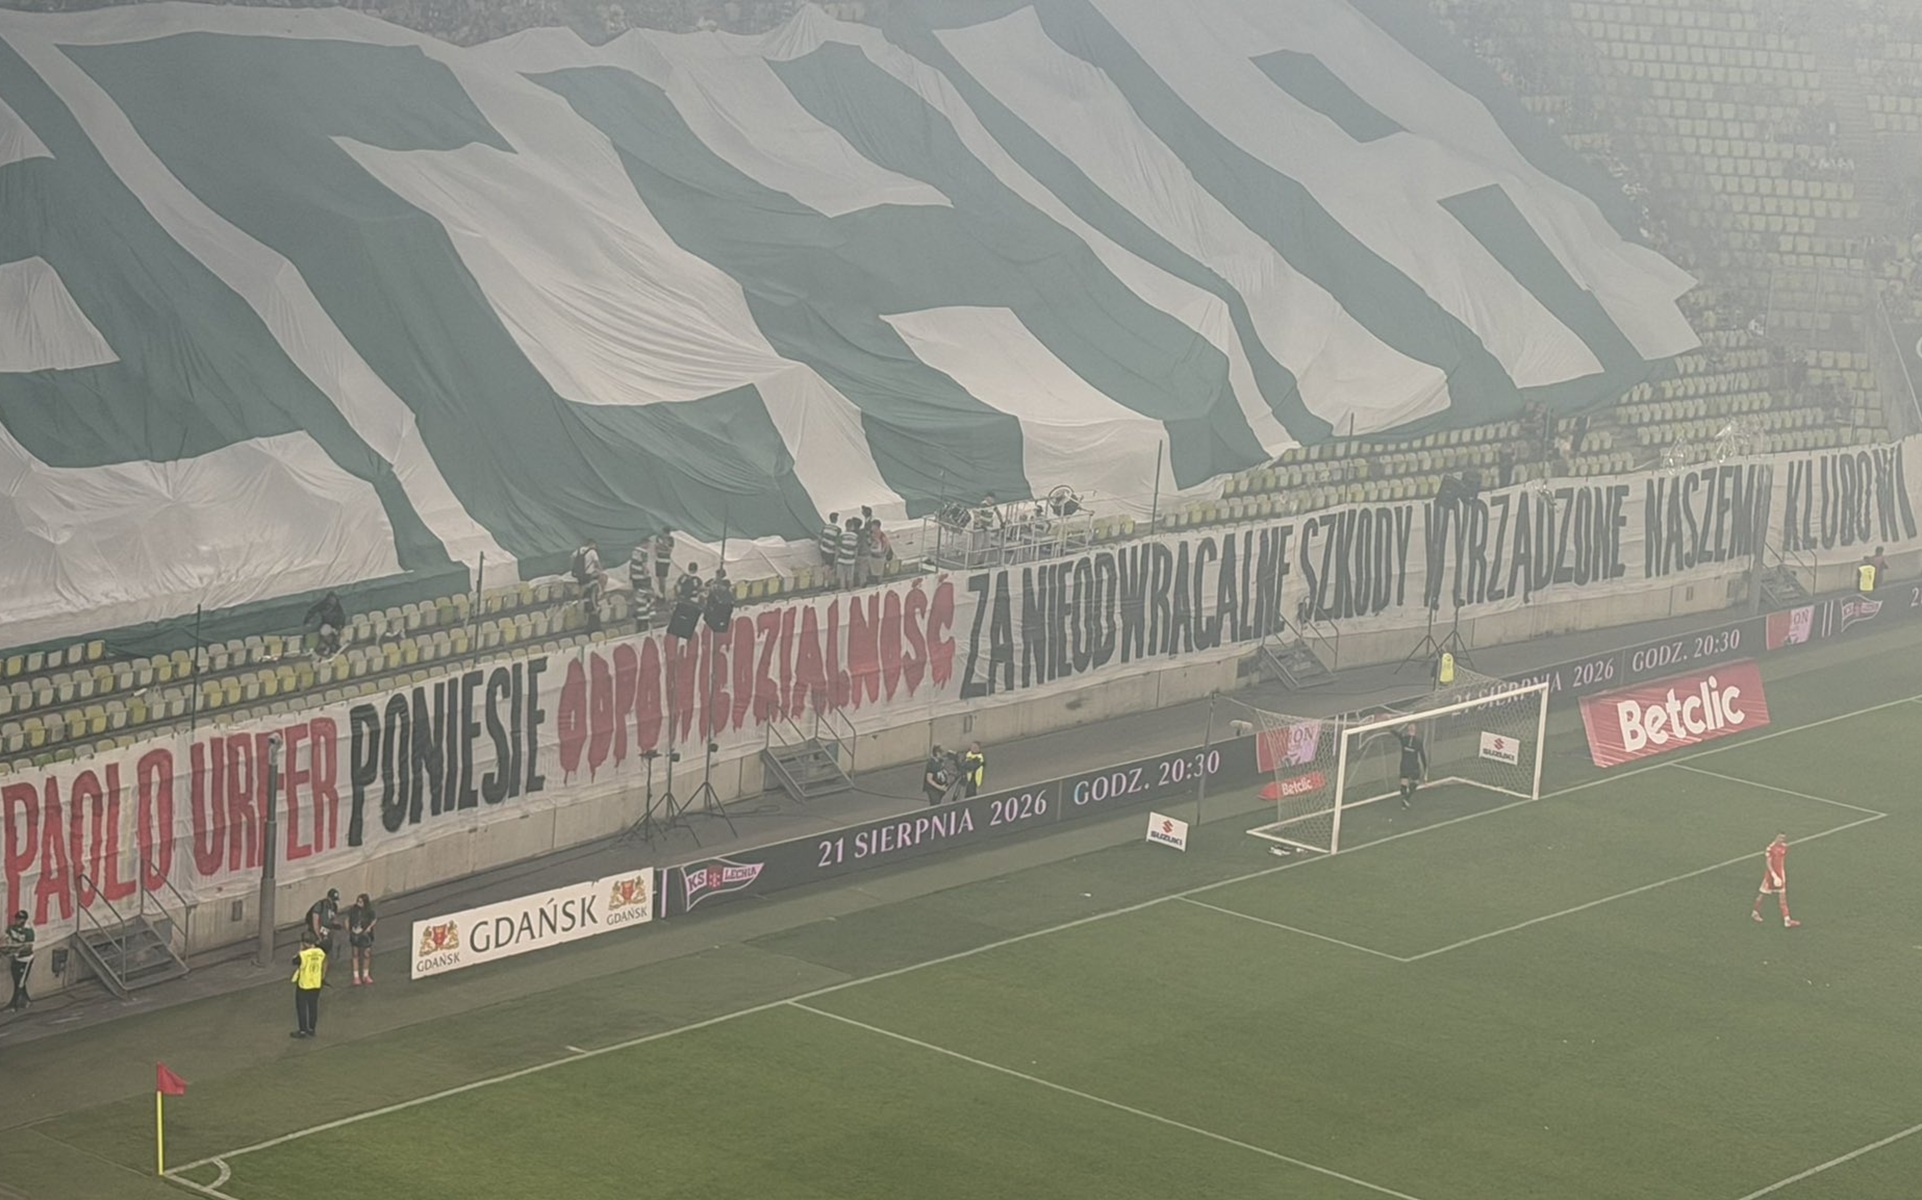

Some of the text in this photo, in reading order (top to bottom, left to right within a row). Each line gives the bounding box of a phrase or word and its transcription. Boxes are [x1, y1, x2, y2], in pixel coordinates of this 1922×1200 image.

[1572, 657, 1614, 688] 2026
[1631, 642, 1687, 672] GODZ.
[1693, 628, 1740, 658] 20:30
[1, 748, 173, 925] PAOLO
[190, 717, 339, 876] URFER
[348, 657, 548, 847] PONIESIE
[558, 573, 956, 784] ODPOWIEDZIALNOŚĆ
[959, 570, 1015, 700] ZA
[1021, 524, 1294, 689] NIEODWRACALNE
[1299, 506, 1413, 624] SZKODY
[1783, 442, 1917, 552] KLUBOWI
[1617, 675, 1745, 752] Betclic
[1482, 748, 1515, 761] SUZUKI
[1281, 776, 1313, 796] Betclic
[817, 749, 1220, 867] 21 SIERPNIA 2026 GODZ. 20:30
[1150, 830, 1183, 846] SUZUKI
[687, 866, 757, 891] KS LECHIA
[469, 894, 598, 954] GDAŃSK
[606, 906, 648, 927] GDAŃSK
[416, 952, 461, 973] GDAŃSK
